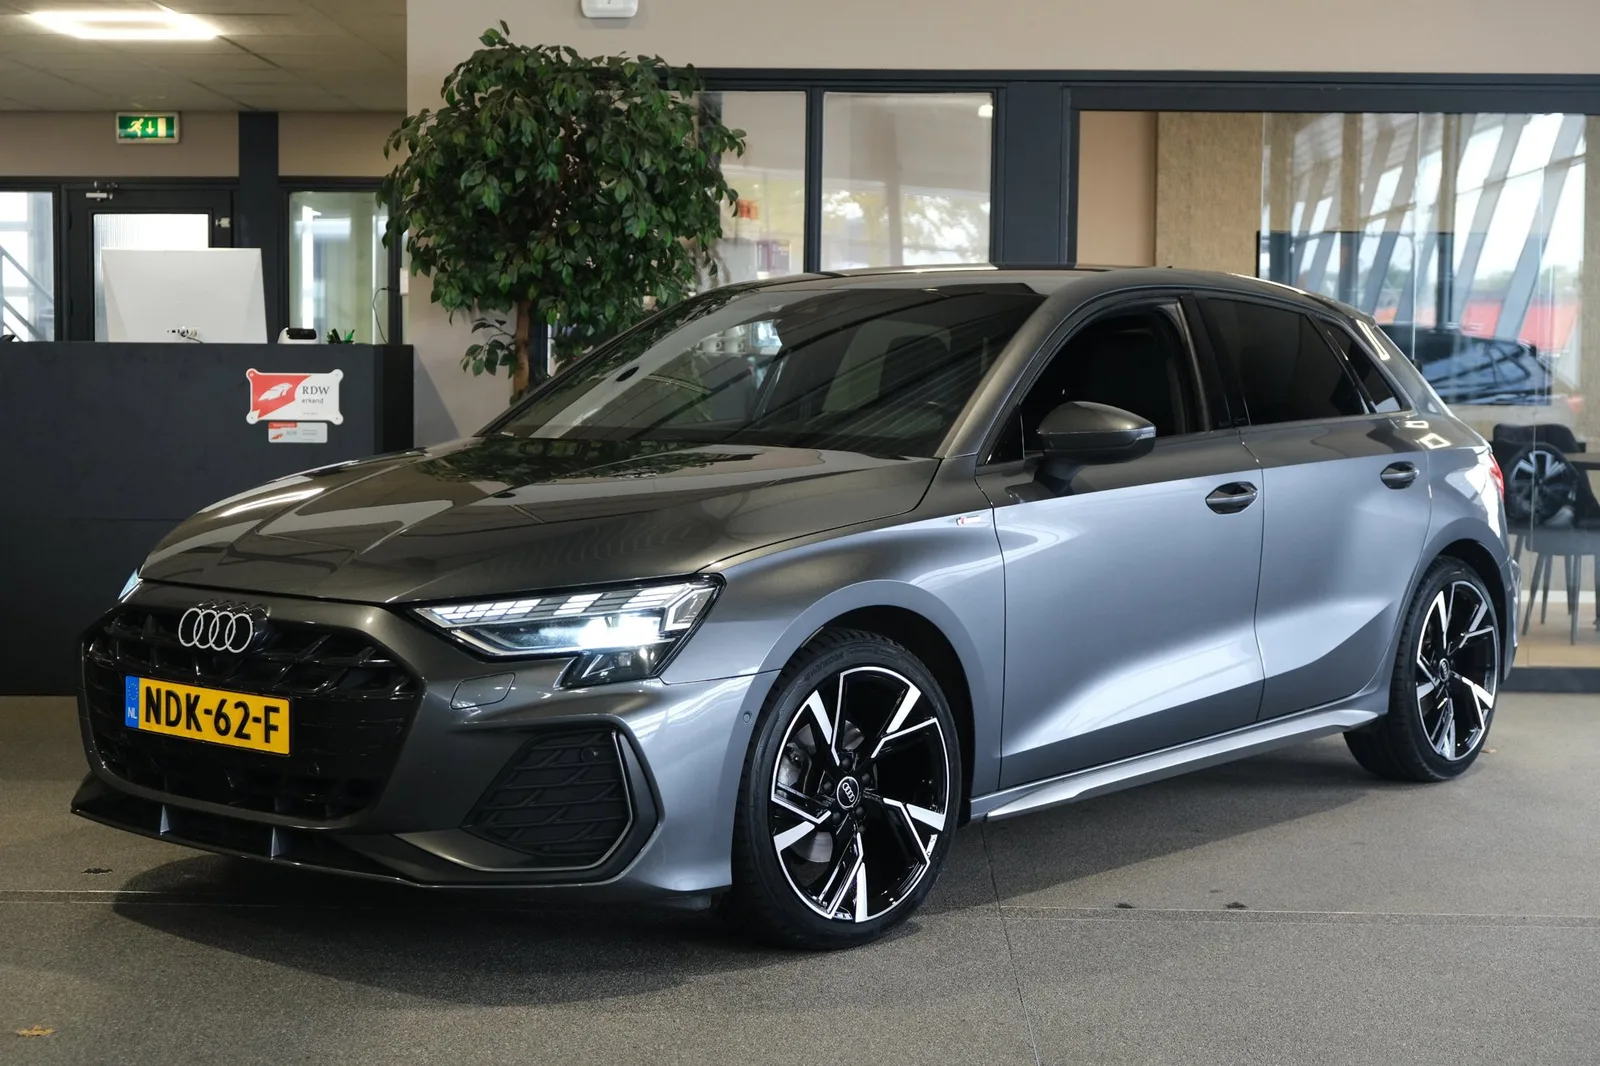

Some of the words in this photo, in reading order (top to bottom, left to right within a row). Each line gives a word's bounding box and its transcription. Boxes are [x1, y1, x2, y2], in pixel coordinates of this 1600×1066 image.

[302, 385, 330, 395] RDW
[127, 706, 138, 719] NL
[145, 686, 280, 743] NDK-62-F
